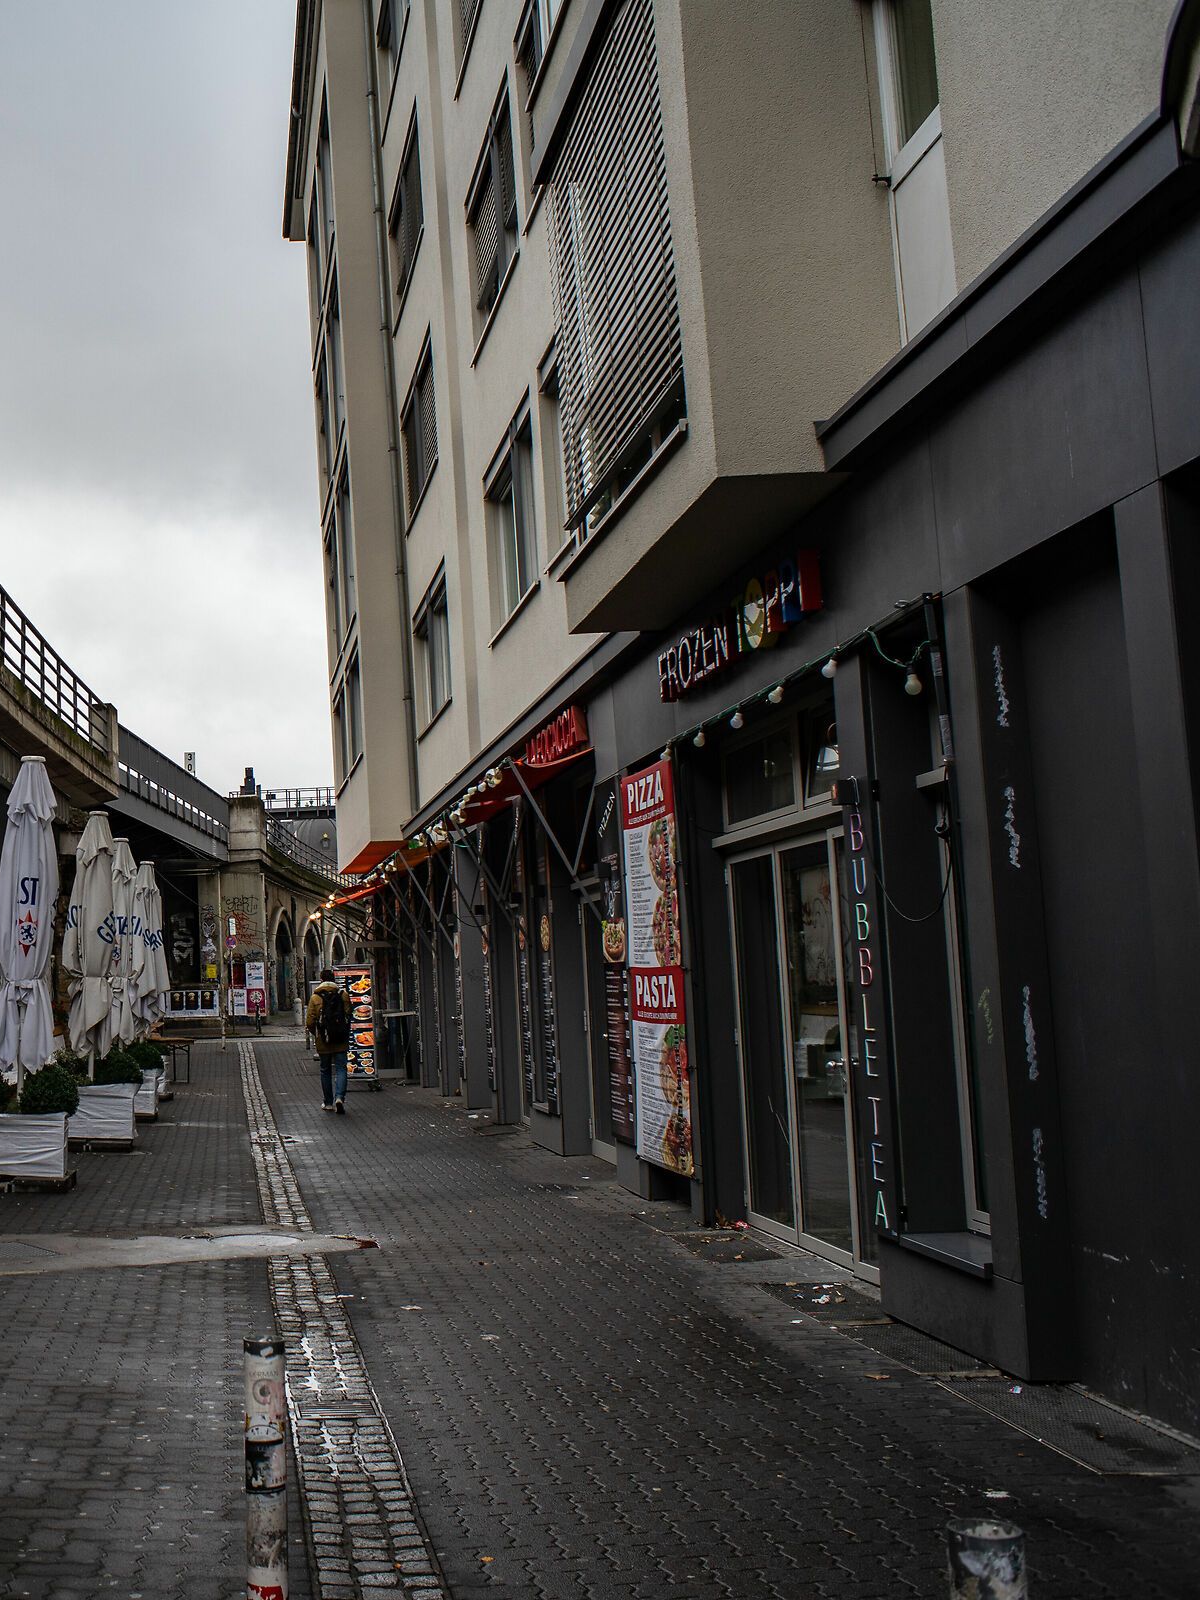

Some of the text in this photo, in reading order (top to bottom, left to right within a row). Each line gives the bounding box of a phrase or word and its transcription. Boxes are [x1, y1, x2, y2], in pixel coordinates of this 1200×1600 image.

[658, 623, 730, 699] FROZEN
[626, 769, 664, 815] PIZZA
[634, 974, 678, 1009] PASTA
[850, 813, 889, 1230] BUBBLE TEA
